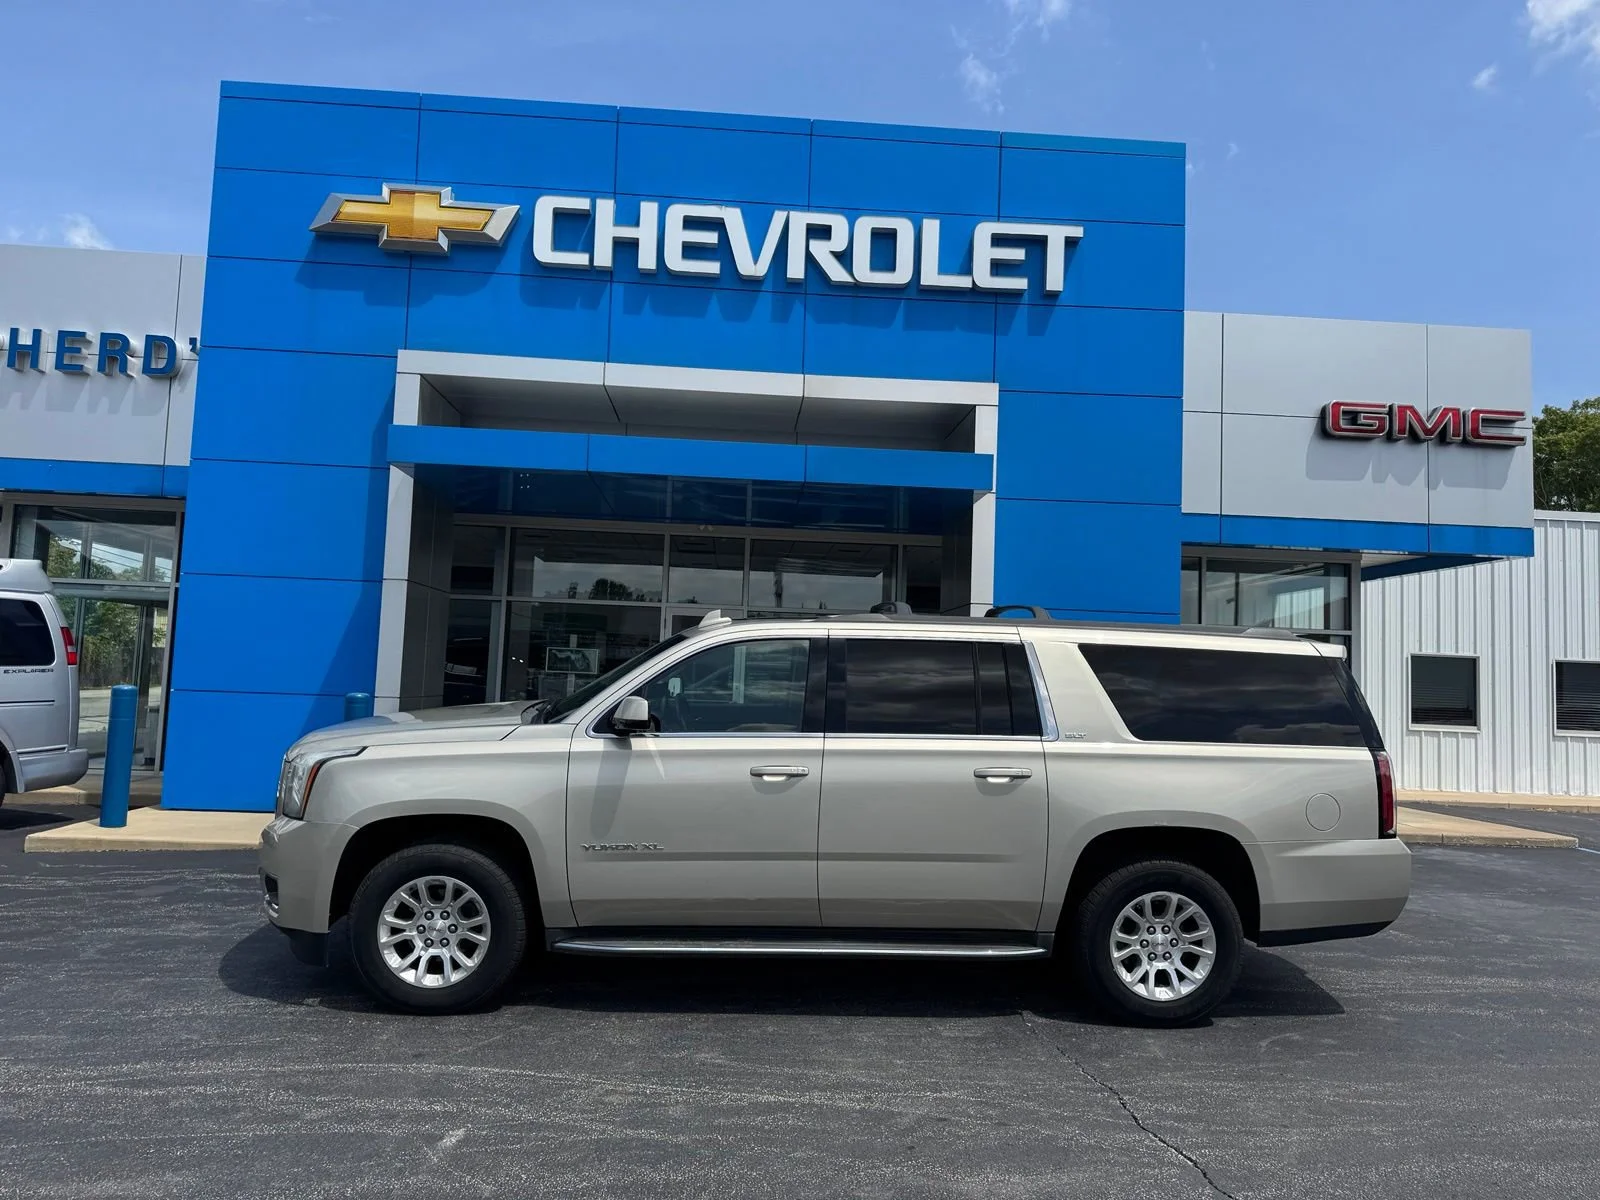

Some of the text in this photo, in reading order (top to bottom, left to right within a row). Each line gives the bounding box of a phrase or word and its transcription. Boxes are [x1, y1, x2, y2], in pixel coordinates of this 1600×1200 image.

[533, 195, 1084, 293] CHEVROLET
[0, 327, 198, 378] HERD'
[1322, 400, 1527, 447] GMC
[580, 842, 665, 851] YUKON XL
